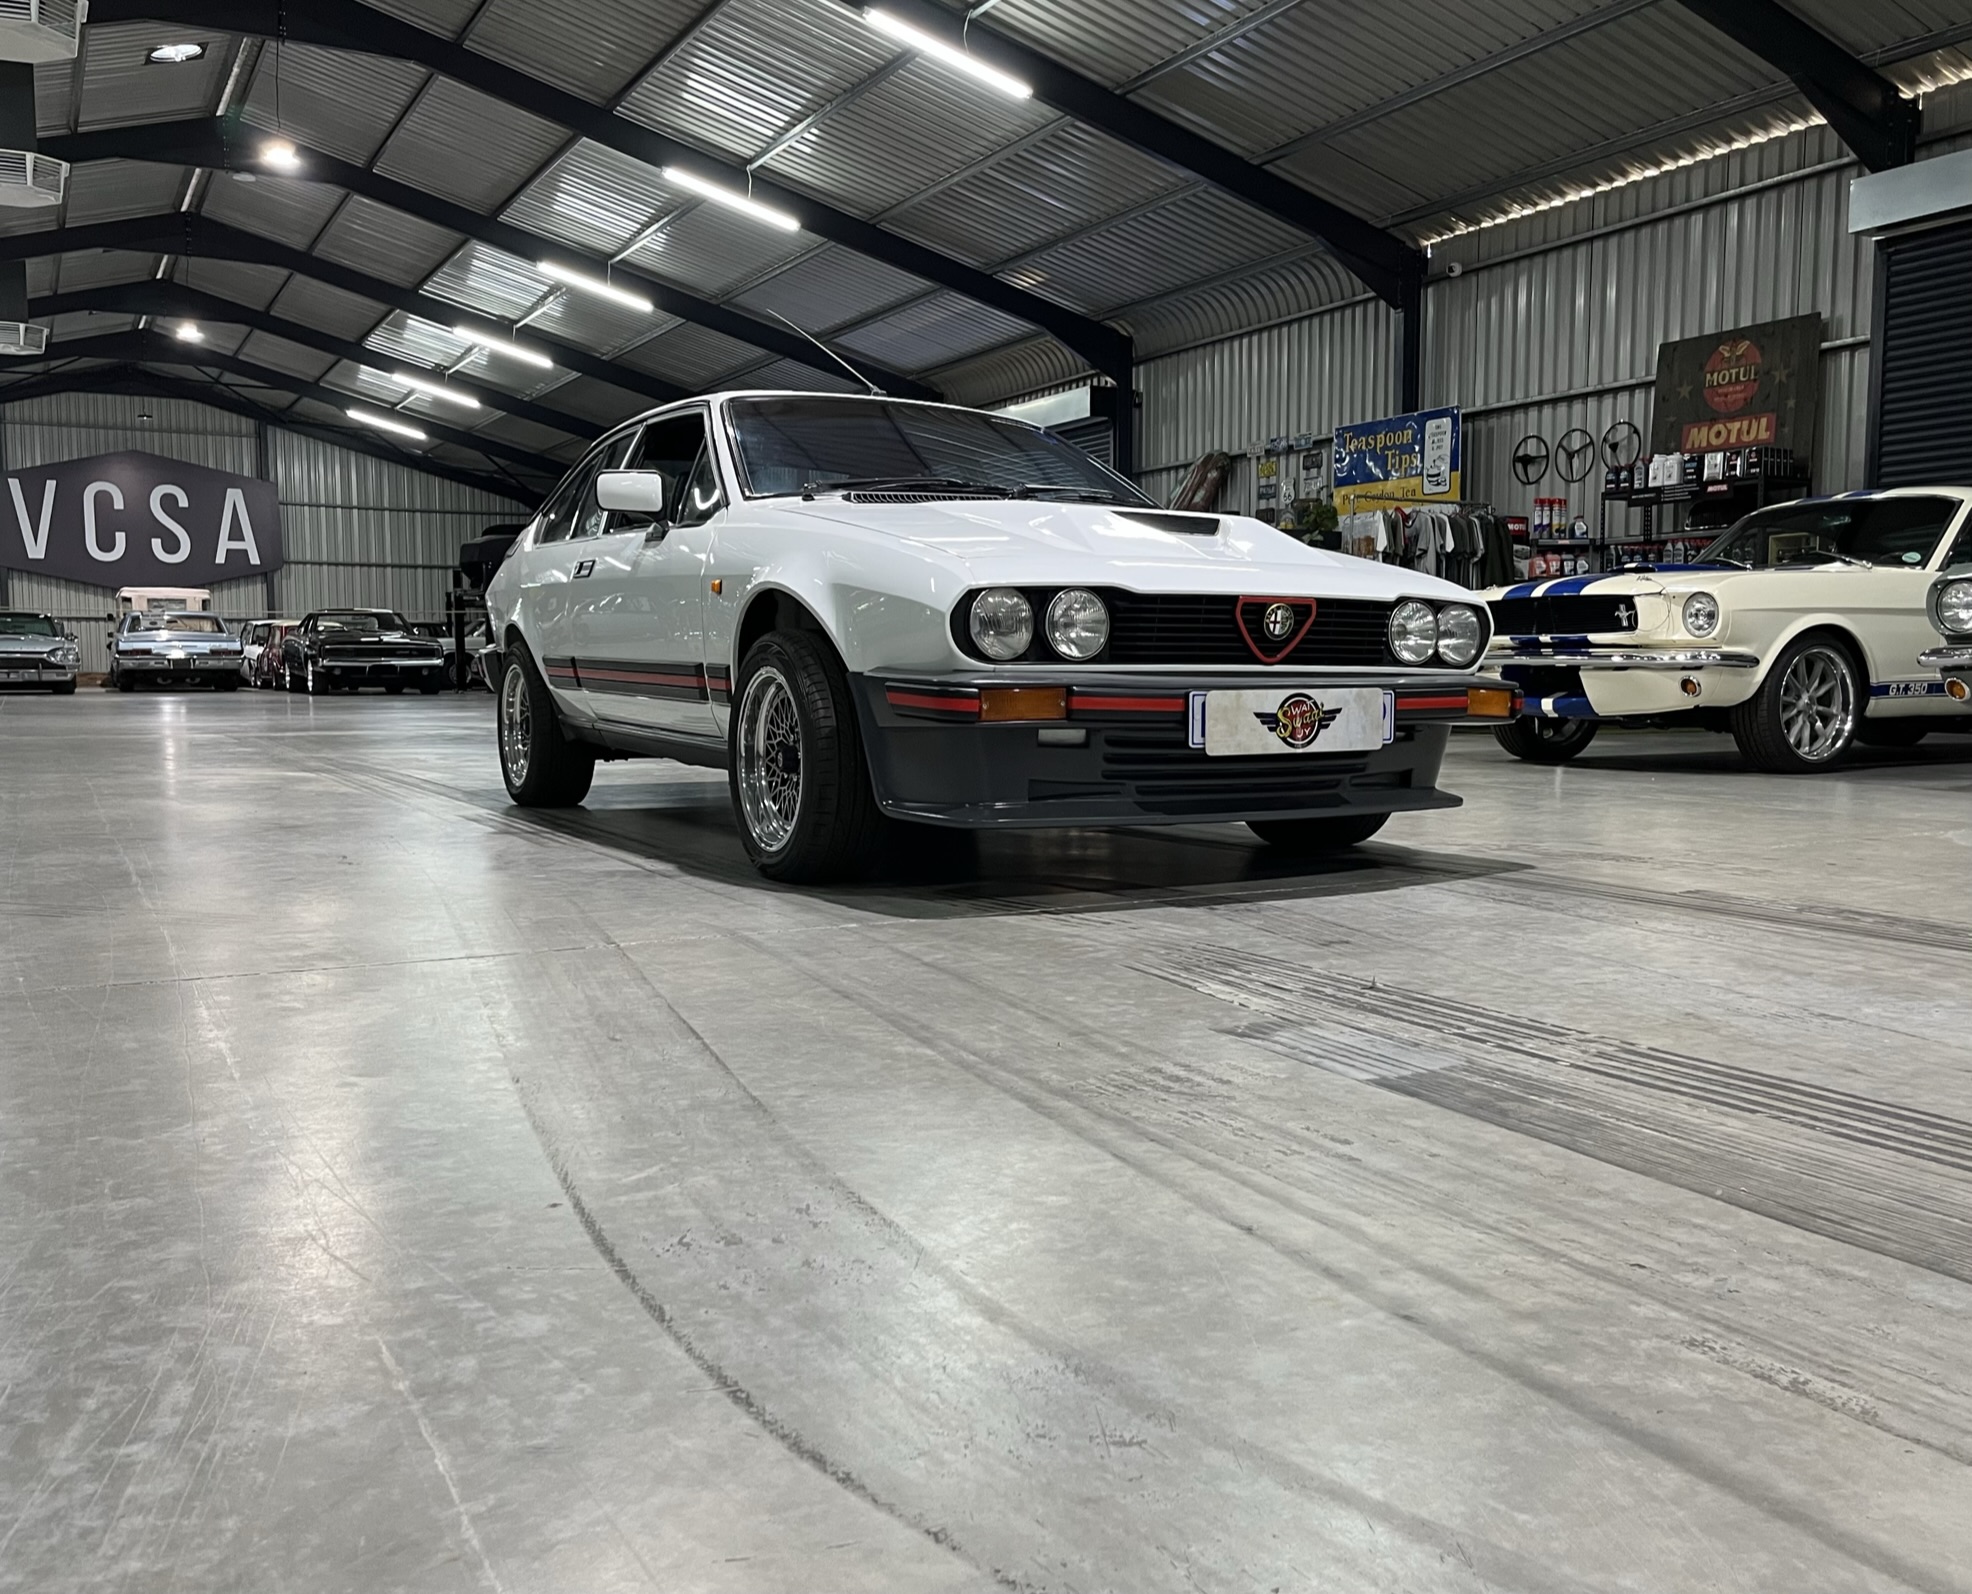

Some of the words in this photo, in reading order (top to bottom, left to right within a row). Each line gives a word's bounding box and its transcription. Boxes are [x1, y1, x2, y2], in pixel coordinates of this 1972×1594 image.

[1705, 365, 1758, 387] MOTUL
[1343, 428, 1412, 454] Teaspoon
[1686, 417, 1769, 449] MOTUL
[1385, 449, 1418, 477] Tips
[1283, 492, 1292, 502] 66
[1400, 486, 1416, 498] Tea
[1707, 484, 1728, 493] MOTUL
[8, 478, 260, 566] VCSA
[1907, 683, 1928, 694] 350
[1290, 699, 1314, 715] WAT
